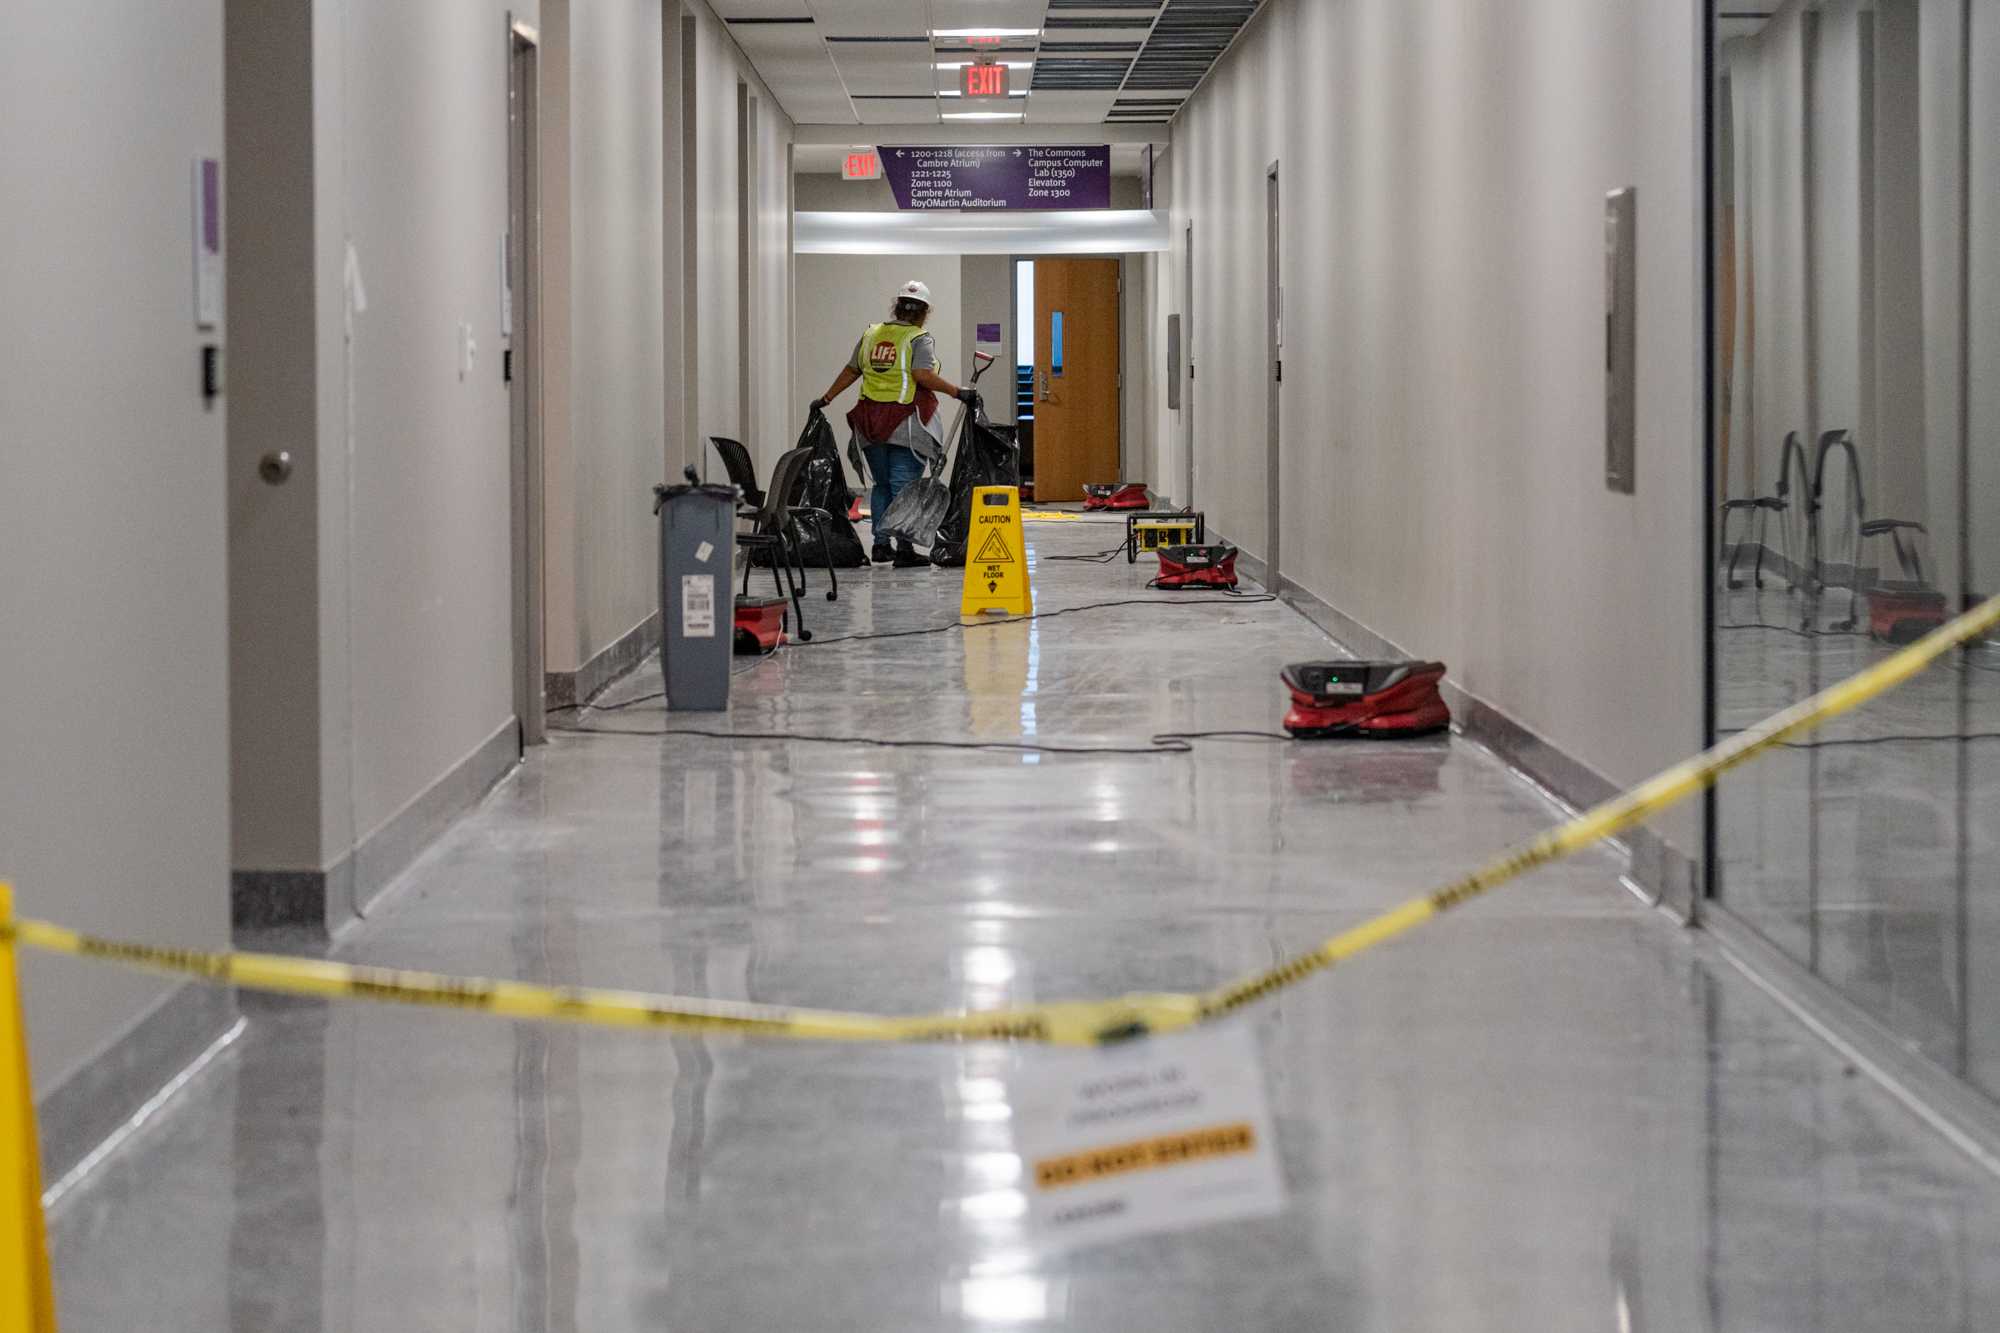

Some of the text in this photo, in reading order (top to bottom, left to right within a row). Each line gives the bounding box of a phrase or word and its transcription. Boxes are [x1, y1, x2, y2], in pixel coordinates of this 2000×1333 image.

[967, 66, 1003, 96] EXIT
[911, 149, 1006, 158] 1200-1218 (access from
[1028, 149, 1086, 157] The Commons
[847, 153, 876, 177] EXIT
[917, 159, 981, 169] Cambre Atrium)
[1028, 159, 1104, 169] Campus Computer
[911, 170, 952, 179] 1221-1225
[1034, 168, 1076, 178] Lab (1350)
[911, 179, 952, 188] Zone 1100
[1028, 178, 1066, 187] Elevators
[911, 189, 972, 197] Cambre Atrium
[1028, 188, 1071, 198] Zone 1300
[911, 199, 1007, 208] RoyOMartin Auditorium
[871, 345, 896, 361] LIFE
[978, 515, 1011, 524] CAUTION
